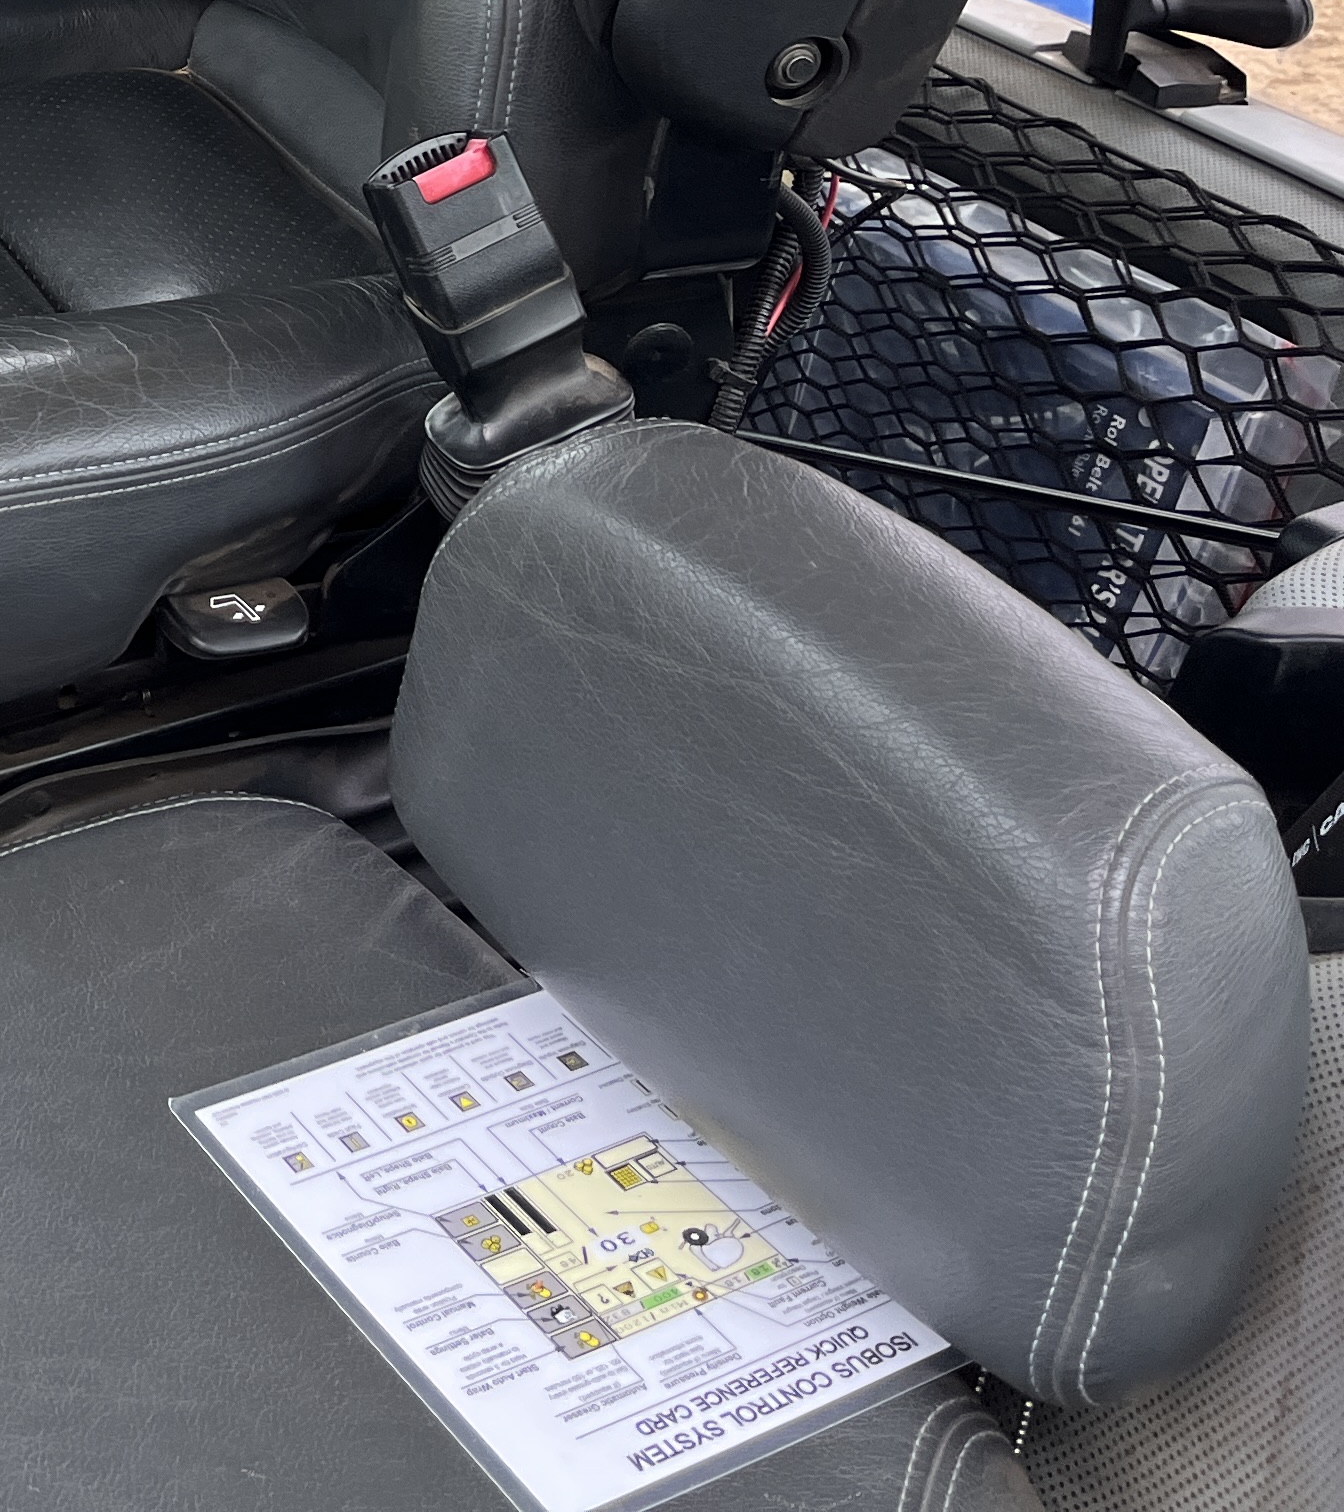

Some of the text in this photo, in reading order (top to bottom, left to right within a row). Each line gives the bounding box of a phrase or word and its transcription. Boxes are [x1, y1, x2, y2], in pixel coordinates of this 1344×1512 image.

[549, 1095, 584, 1111] Current
[503, 1109, 546, 1129] Maximum
[536, 1111, 585, 1134] Bale Count
[410, 1151, 432, 1163] Bale
[361, 1170, 382, 1182] Left
[429, 1163, 452, 1175] Bale
[373, 1181, 401, 1196] Right
[344, 1238, 401, 1264] Bale Counts
[597, 1231, 636, 1253] 30
[791, 1279, 827, 1298] Current
[767, 1294, 793, 1309] Fault
[831, 1293, 868, 1314] Weight
[404, 1299, 476, 1332] Manual Control
[801, 1308, 837, 1329] Option
[427, 1326, 495, 1358] Baler Settings
[463, 1363, 540, 1398] Start Auto Wrap
[632, 1323, 870, 1437] QUICK REFERENCE CARD
[662, 1350, 742, 1390] Density Pressure
[560, 1381, 648, 1424] Automatic Greaser
[625, 1330, 918, 1473] ISOBUS CONTROL SYSTEM
